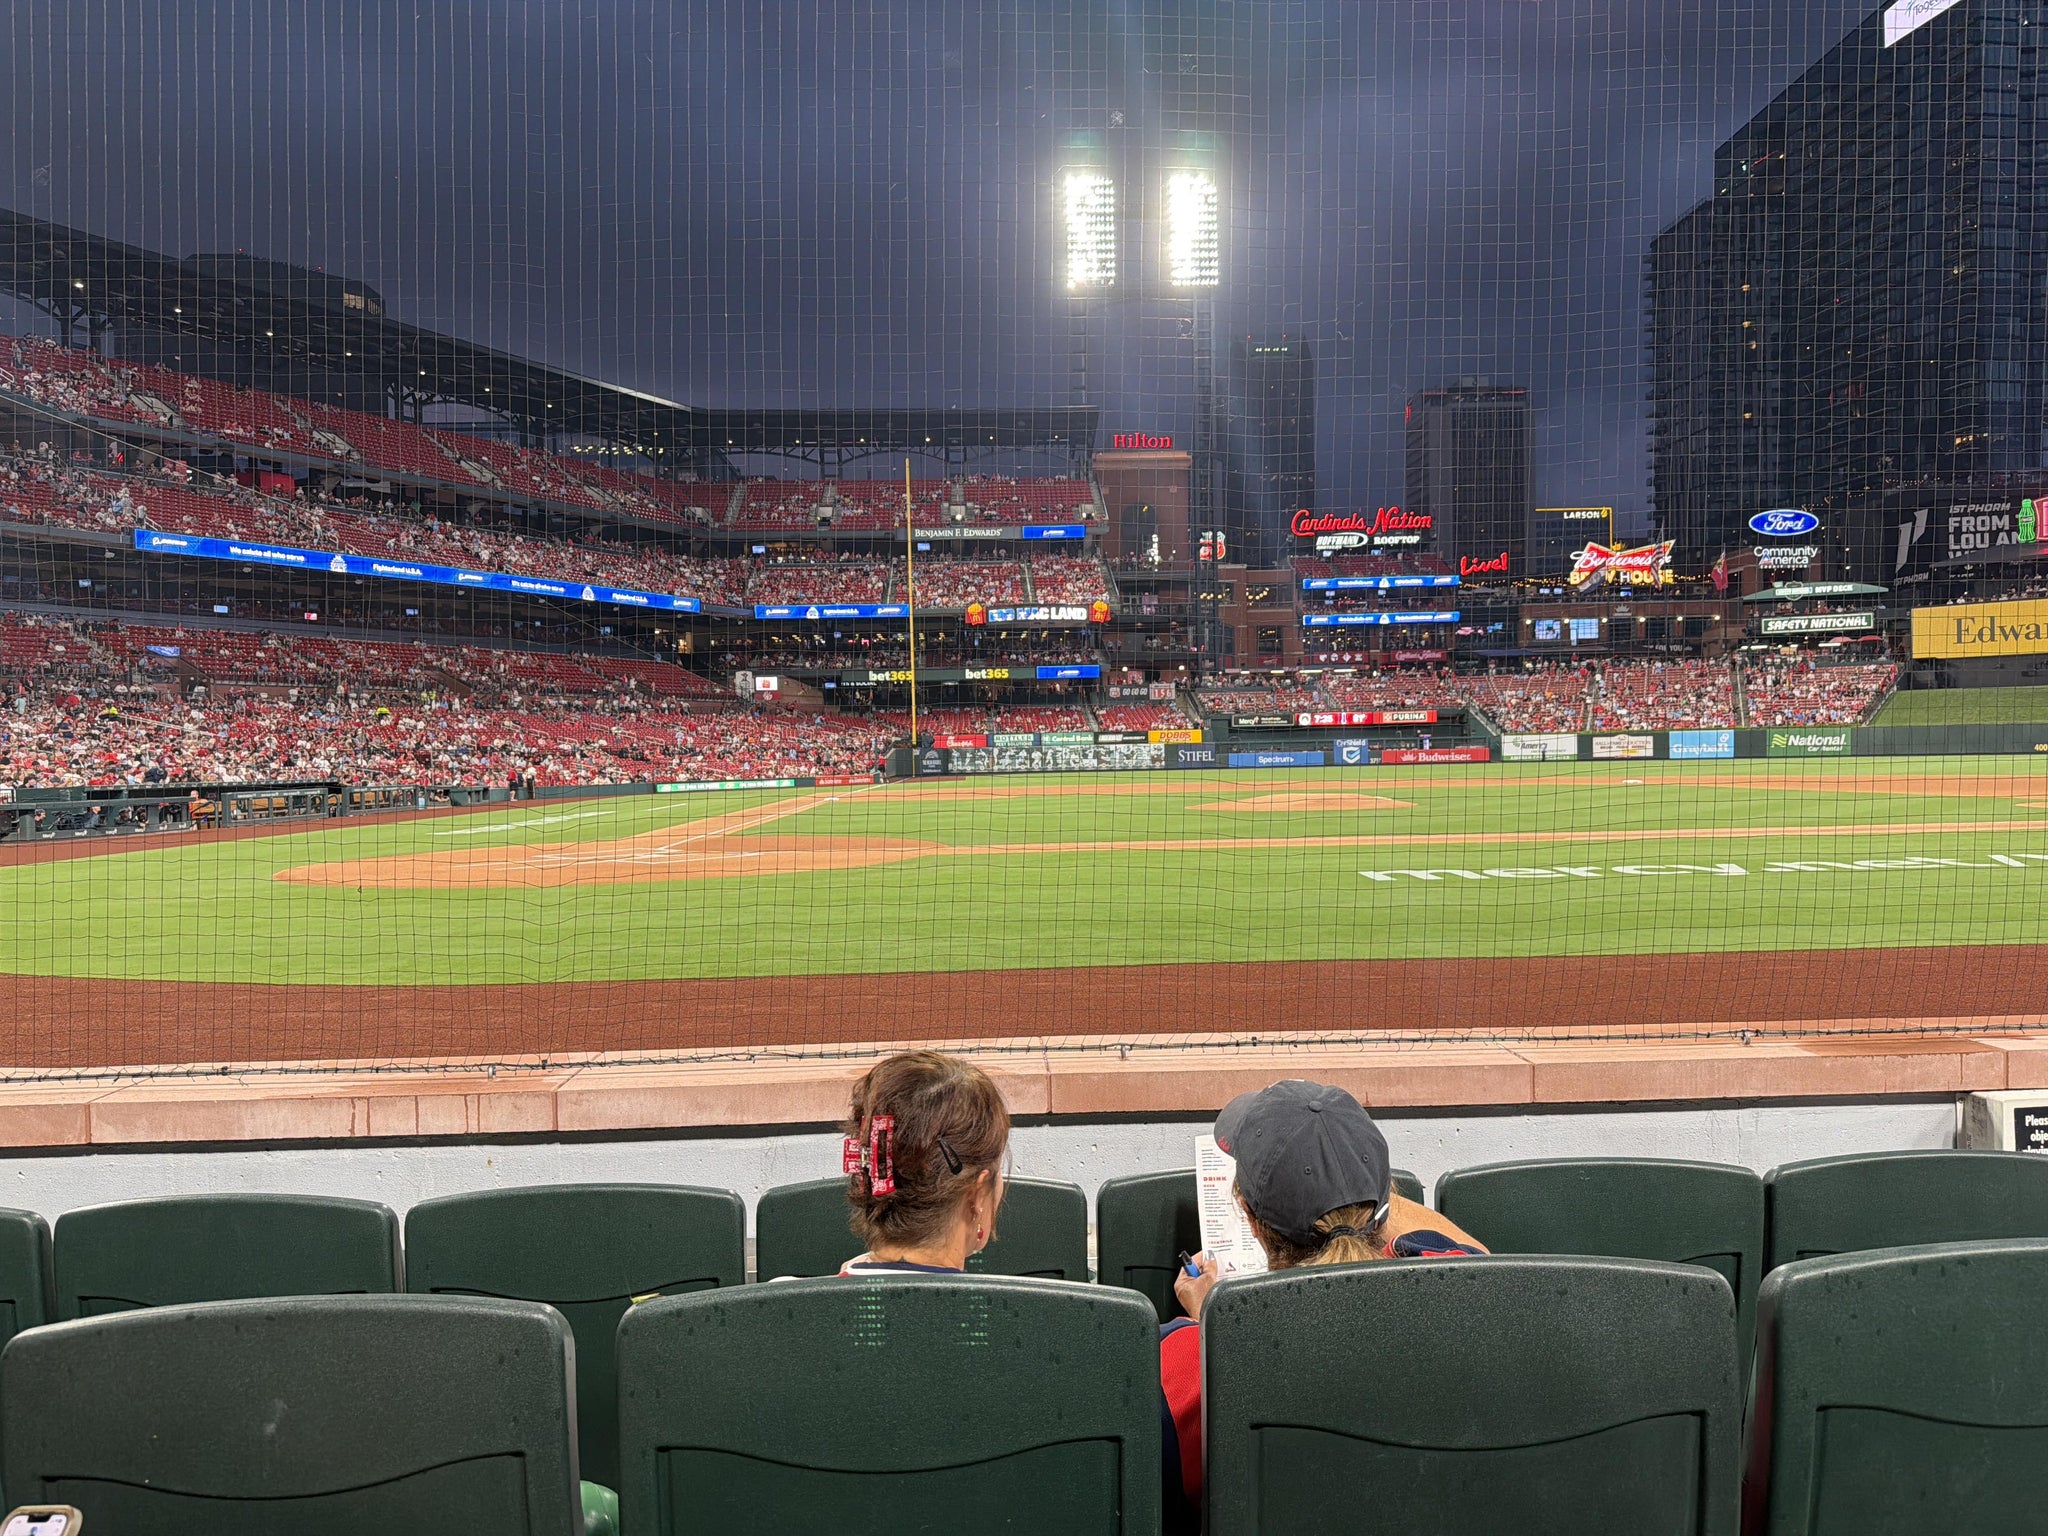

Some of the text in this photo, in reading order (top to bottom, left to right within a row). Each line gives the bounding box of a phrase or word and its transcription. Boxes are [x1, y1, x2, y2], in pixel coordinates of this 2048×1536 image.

[1113, 432, 1173, 449] Hilton
[1969, 503, 2011, 512] PHORM
[1564, 511, 1600, 519] LARSON
[1291, 506, 1432, 537] Cardinals Nation
[1764, 513, 1804, 531] Ford
[1949, 515, 2010, 533] FROM
[914, 528, 1001, 537] BENJAMIN F. EDWARDS
[1316, 535, 1420, 546] HOFFMANN ROOFTOP
[1949, 532, 1994, 549] LOU
[1754, 545, 1818, 558] Community
[1904, 572, 1929, 584] PHORM
[1833, 584, 1853, 592] DECK
[1050, 607, 1087, 620] LAND
[1767, 616, 1868, 631] SAFETY NATIONAL
[869, 671, 912, 681] bet365
[965, 669, 1009, 680] bet365
[1178, 750, 1215, 762] STIFEL
[1418, 752, 1472, 762] Budweiser
